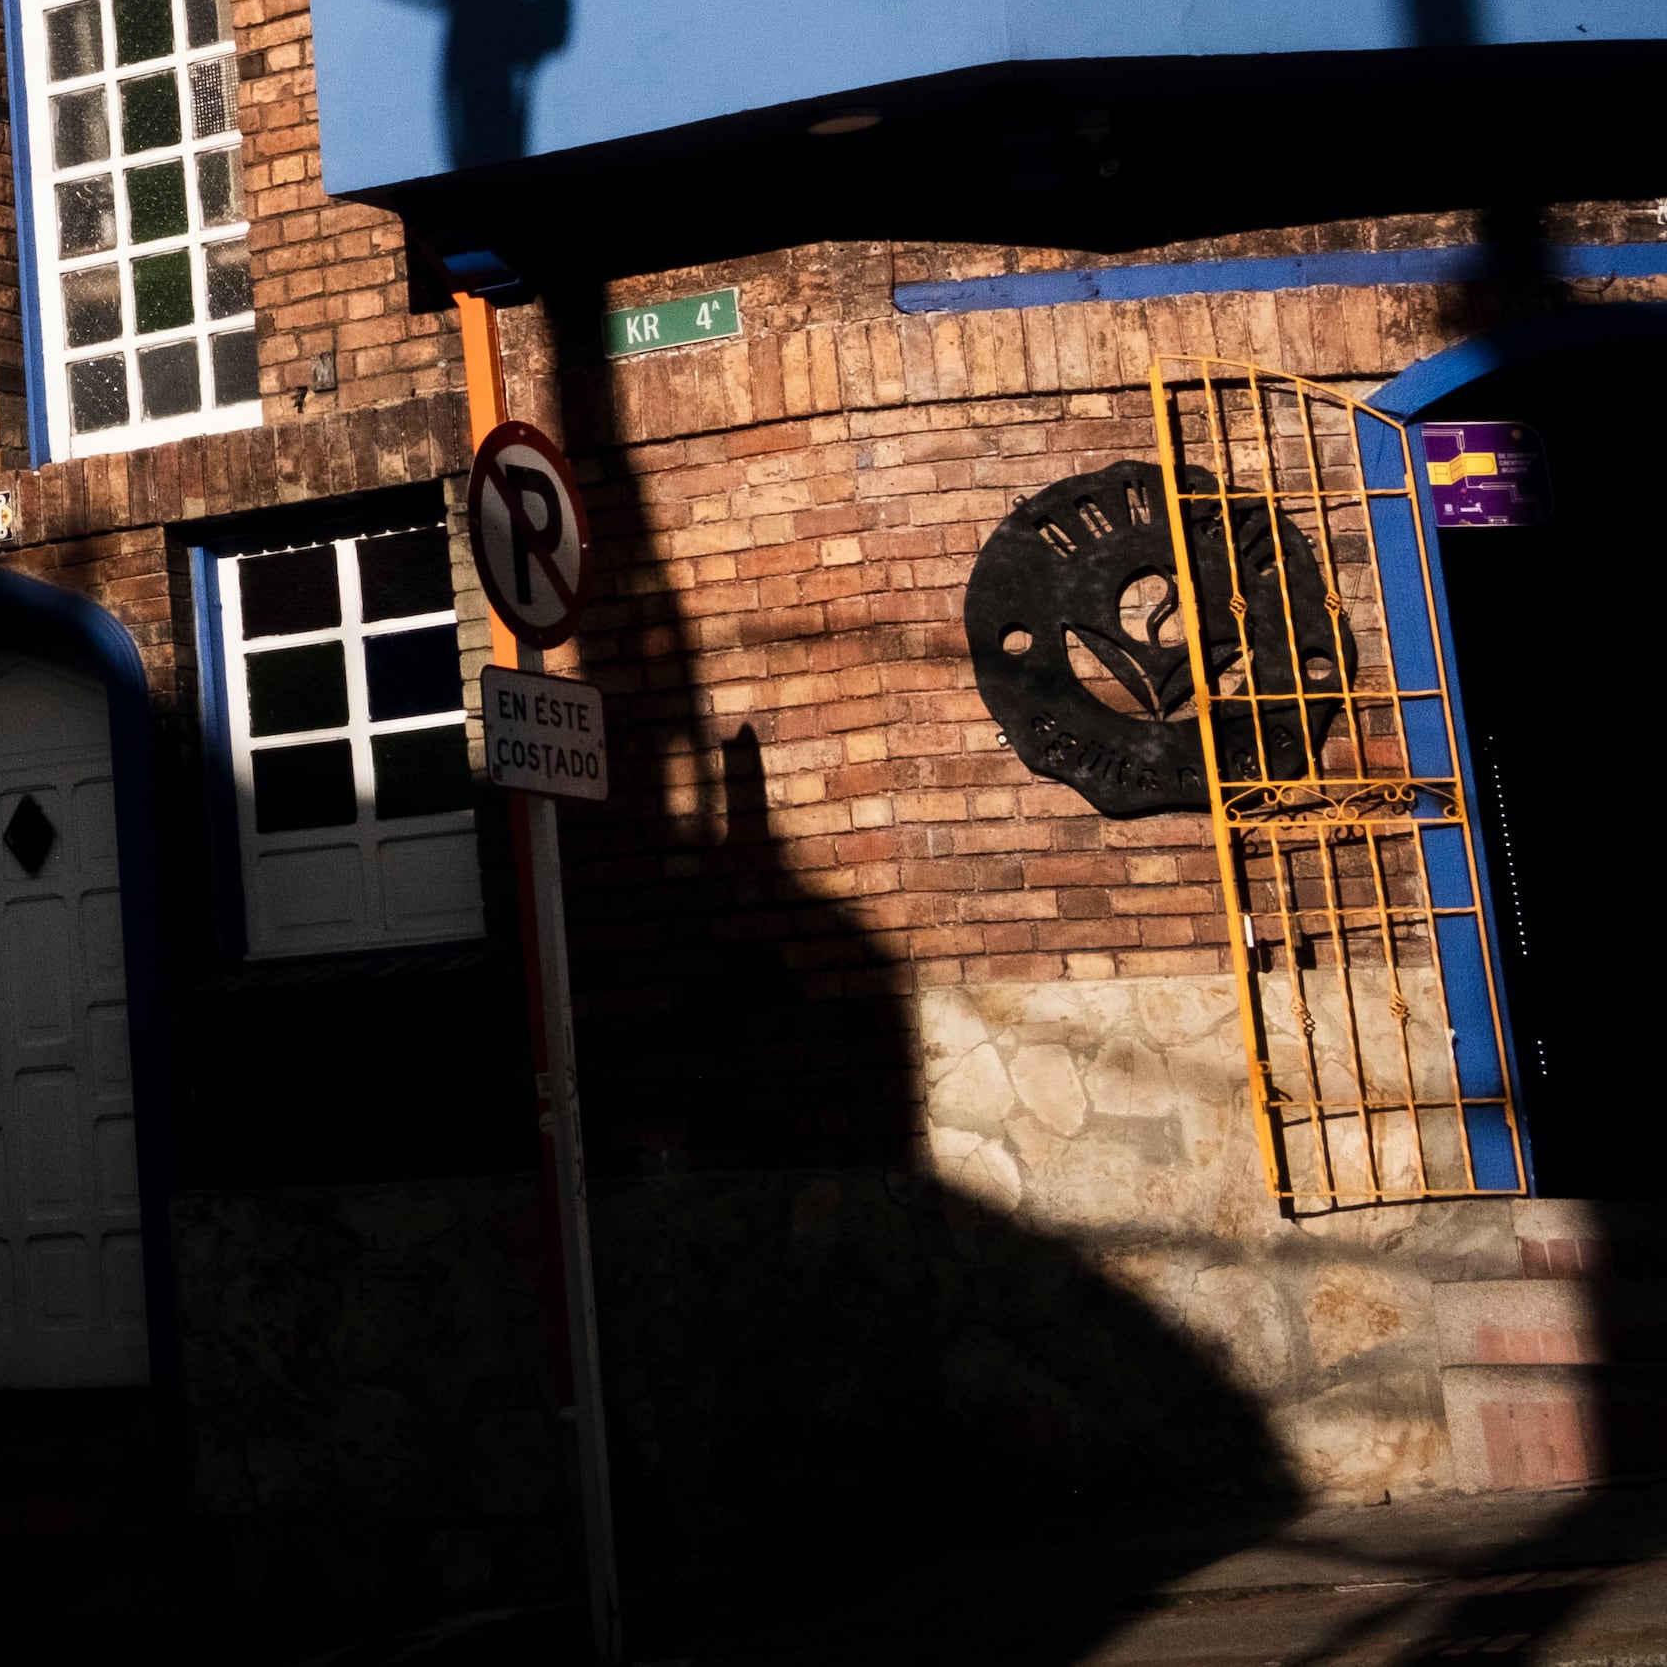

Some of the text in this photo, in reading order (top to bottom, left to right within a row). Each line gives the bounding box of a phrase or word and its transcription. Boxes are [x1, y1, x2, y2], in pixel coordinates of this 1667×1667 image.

[626, 313, 660, 344] KR
[505, 464, 563, 605] P
[498, 690, 527, 723] EN
[497, 738, 599, 780] COSTADO
